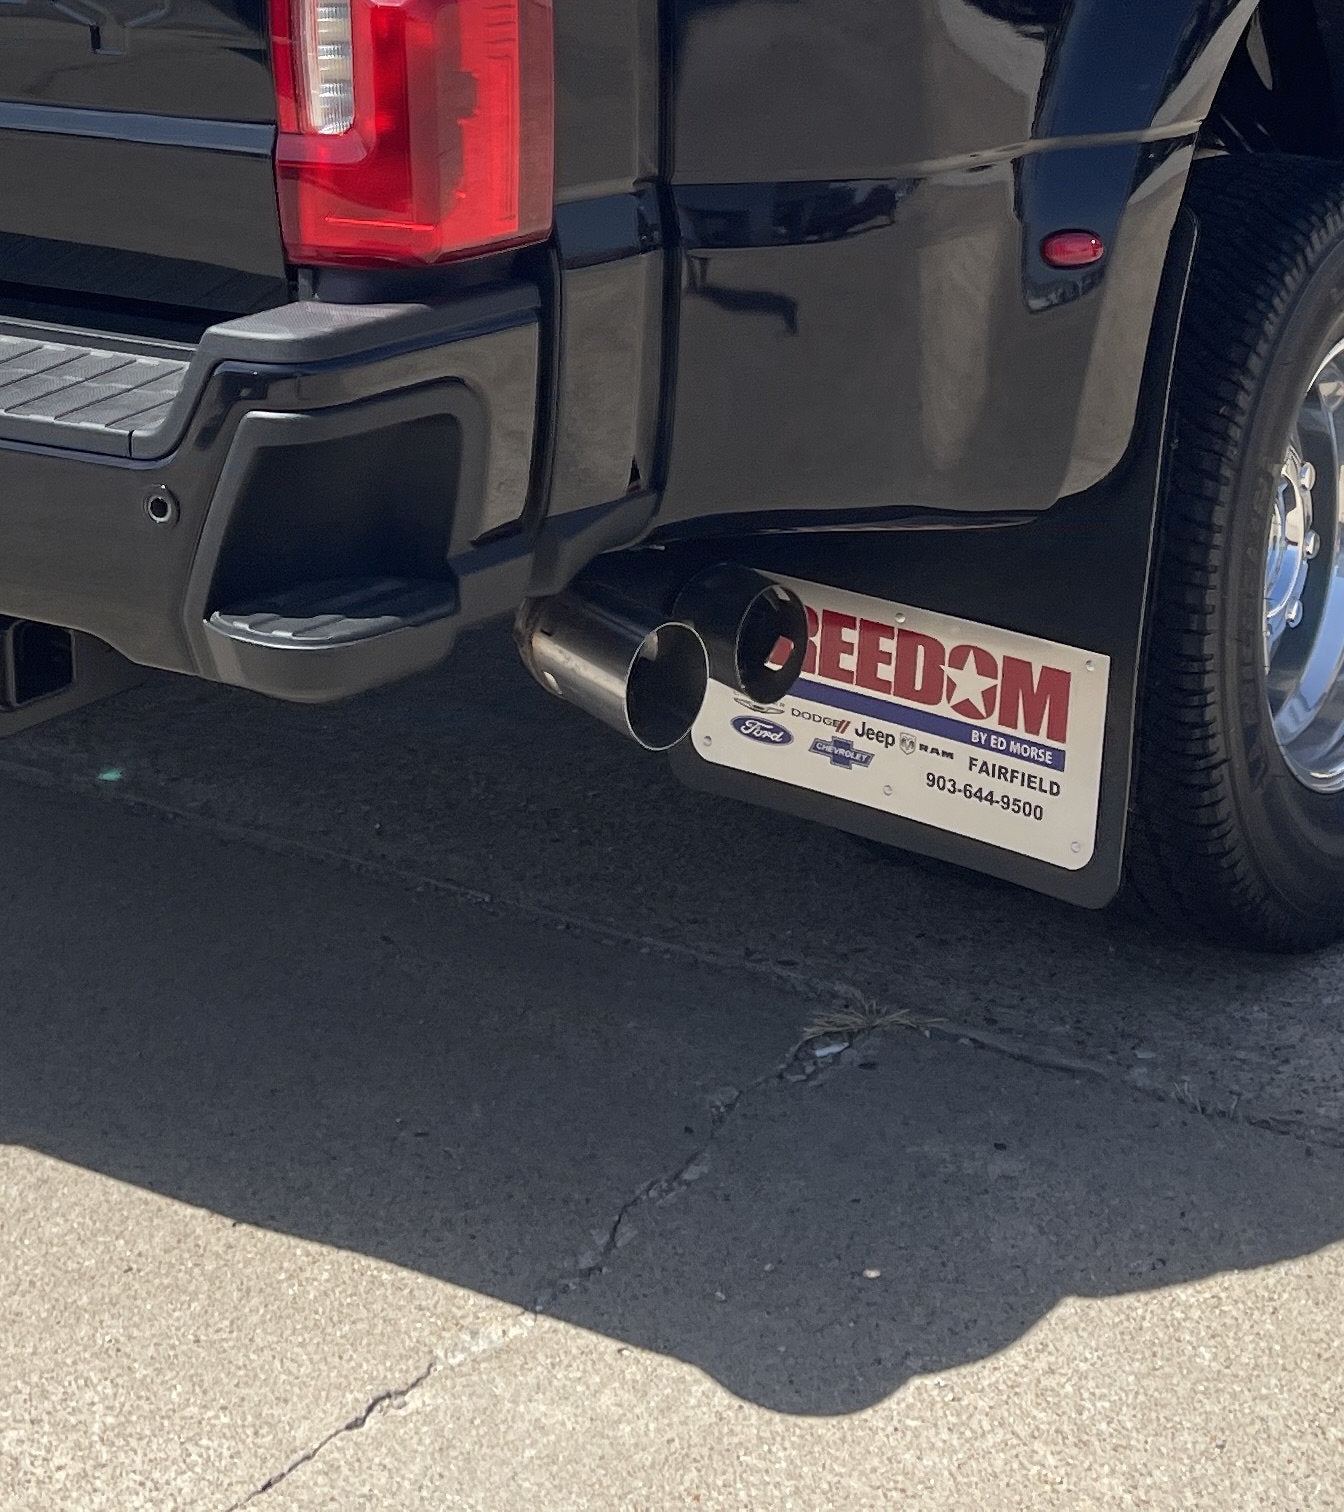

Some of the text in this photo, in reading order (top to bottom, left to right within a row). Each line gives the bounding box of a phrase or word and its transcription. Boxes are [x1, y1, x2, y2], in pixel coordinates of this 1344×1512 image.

[800, 604, 1072, 744] EEDOM
[740, 719, 868, 762] Ford CHEVROLET
[791, 707, 955, 760] DODGE Jeep RAM
[971, 730, 1053, 765] BY ED MORSE
[926, 772, 1044, 821] 903-644-9500
[968, 756, 1061, 796] FAIRFIELD
